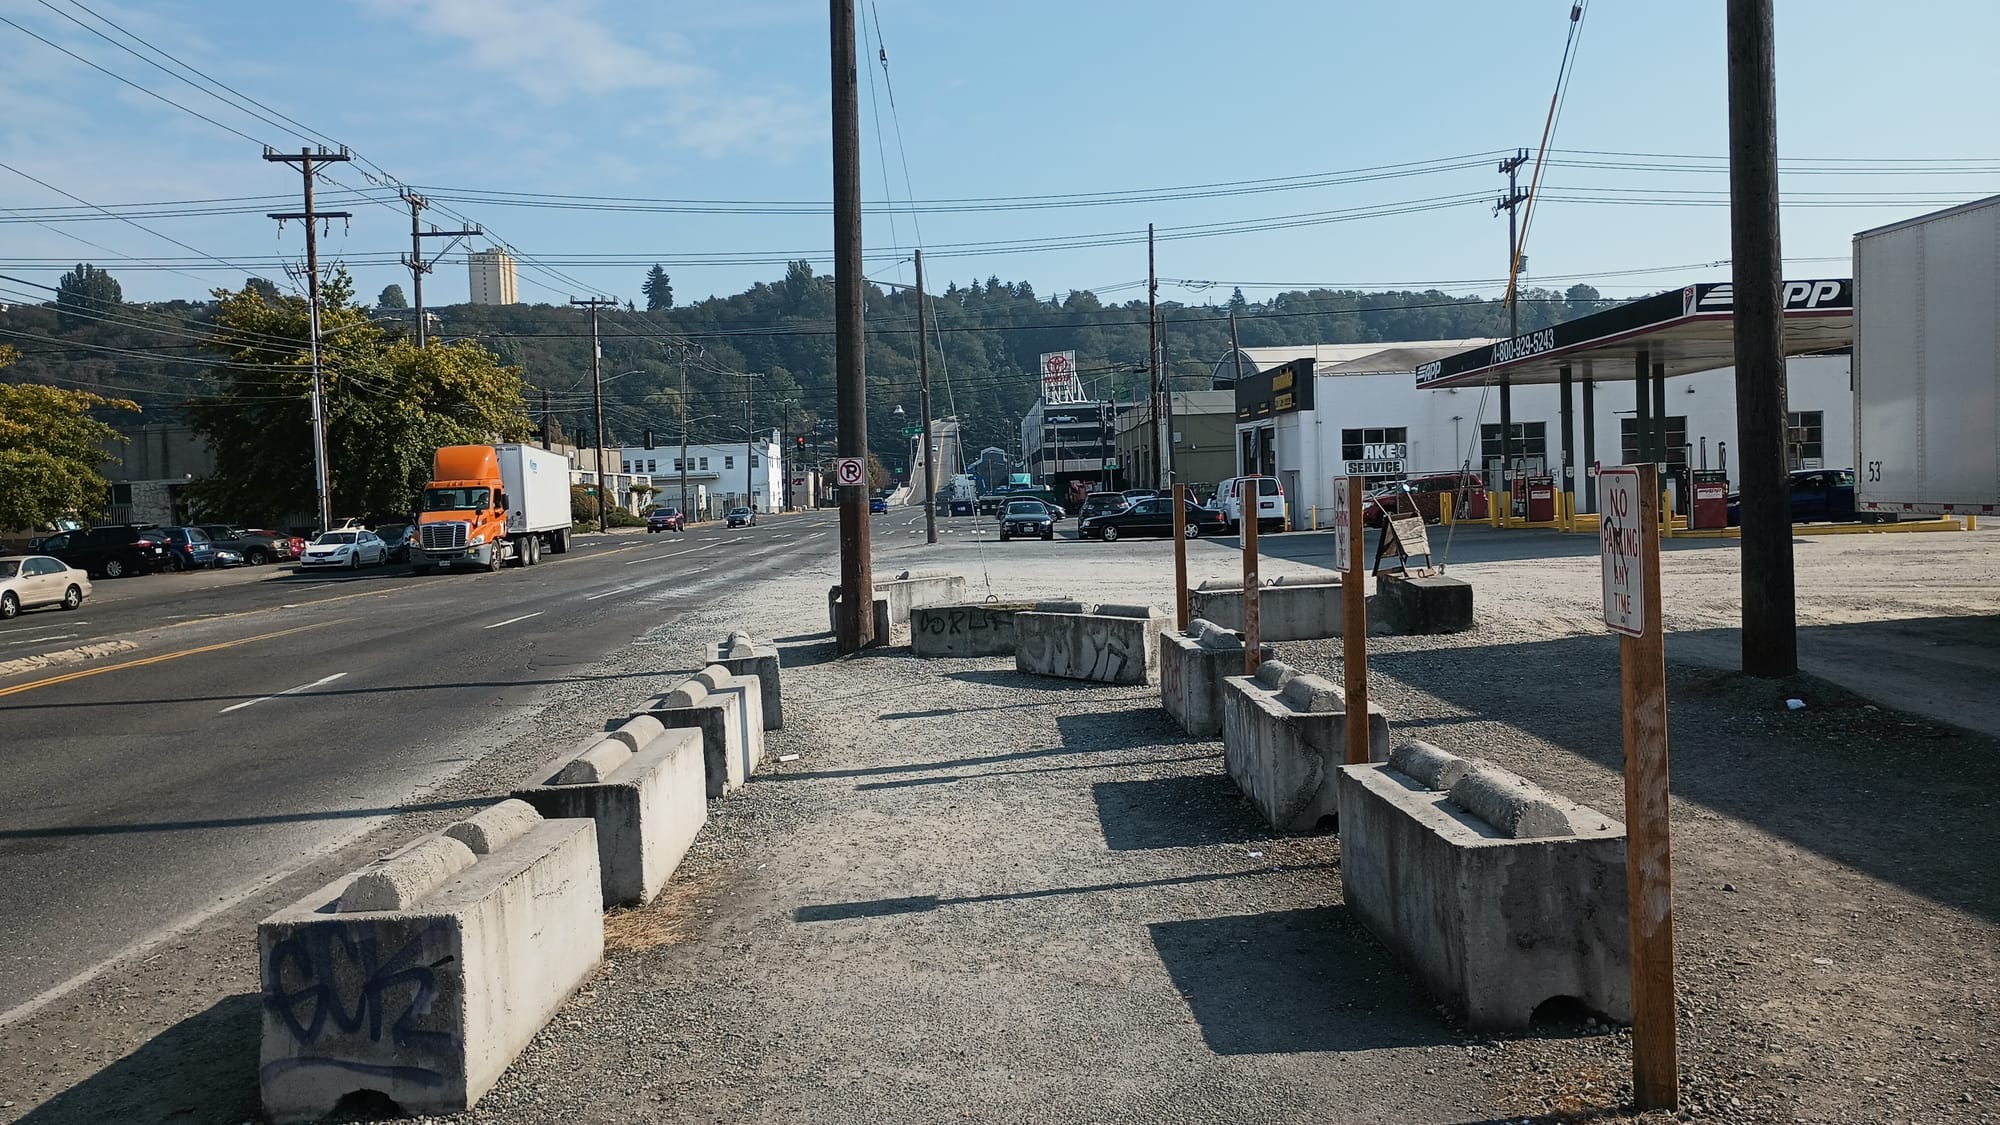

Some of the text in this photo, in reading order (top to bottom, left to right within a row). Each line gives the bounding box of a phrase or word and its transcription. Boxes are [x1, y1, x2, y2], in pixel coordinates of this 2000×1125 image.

[1783, 281, 1841, 308] PP
[1493, 328, 1554, 363] 1-800-929-5243
[1424, 361, 1441, 381] APP
[1348, 461, 1401, 474] SERVICE
[1609, 488, 1628, 517] NO
[1604, 527, 1638, 558] PARKING
[1614, 566, 1629, 587] ANY
[1614, 592, 1632, 615] TIME
